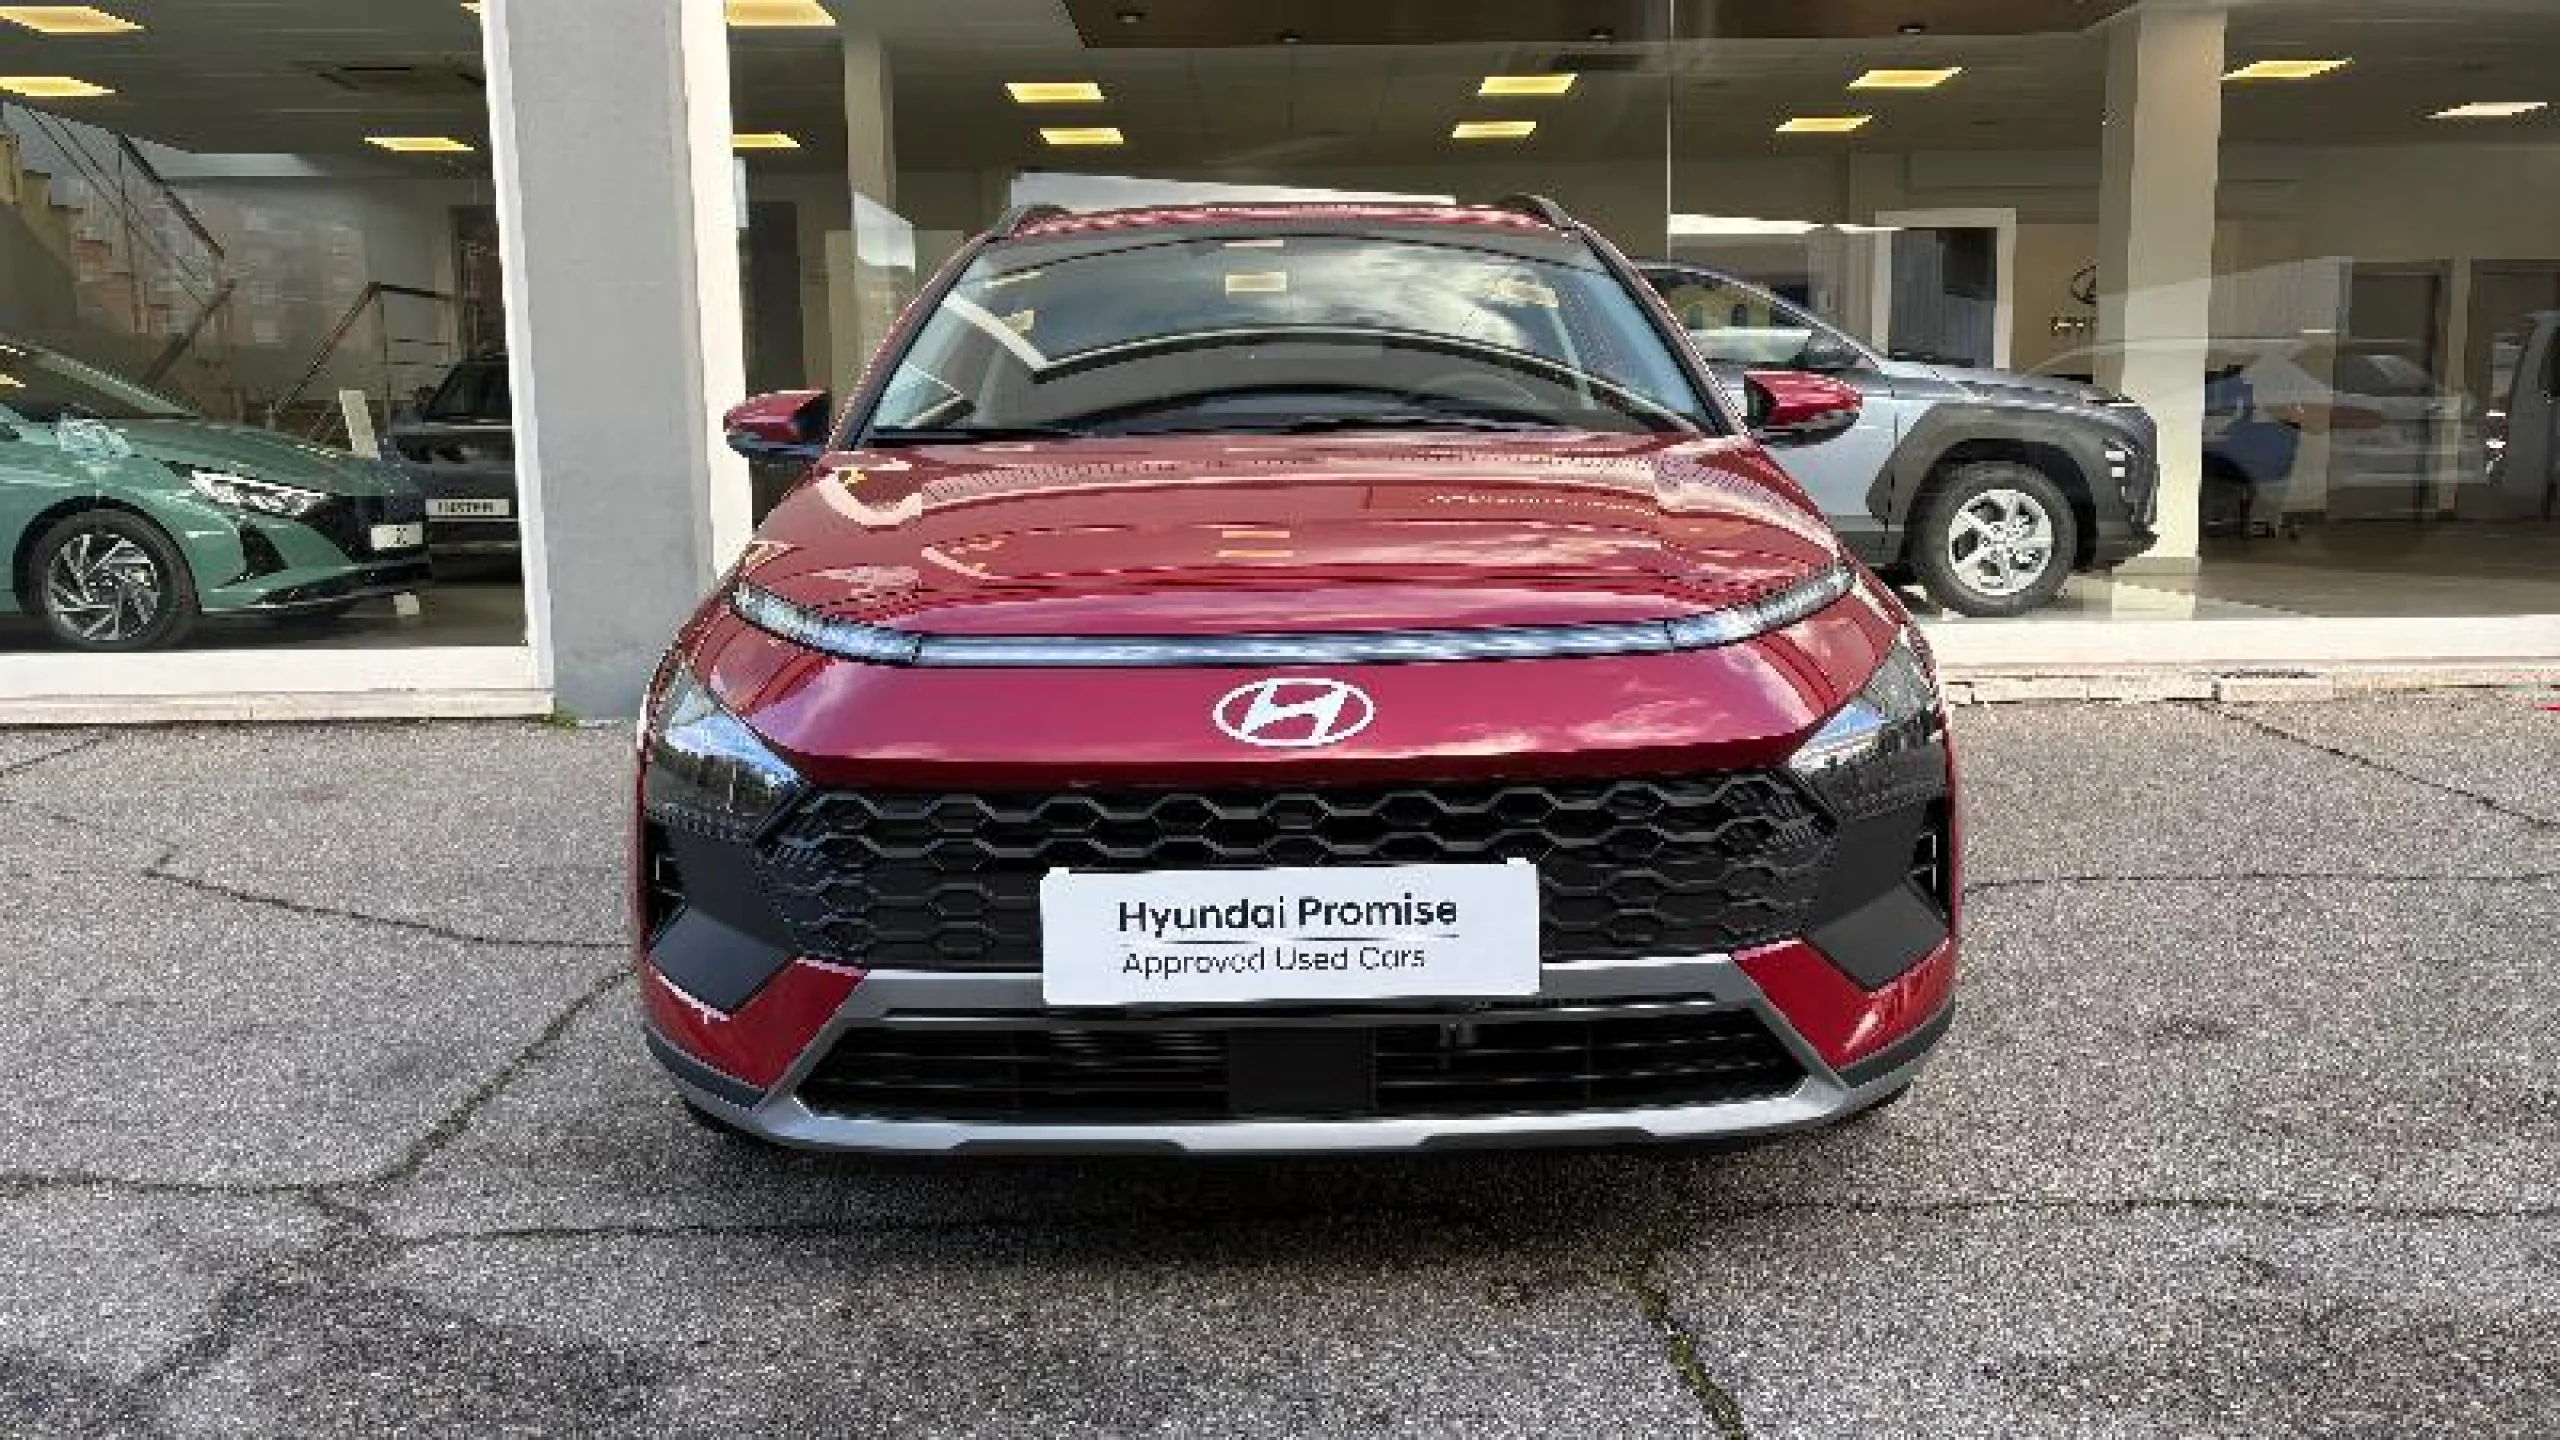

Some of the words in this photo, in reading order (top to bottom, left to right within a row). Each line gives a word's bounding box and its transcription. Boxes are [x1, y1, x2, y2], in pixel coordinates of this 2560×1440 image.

[1119, 895, 1287, 938] Hyundai
[1298, 892, 1457, 926] Promise
[1122, 946, 1264, 979] Approved
[1276, 946, 1347, 970] Used
[1359, 946, 1425, 970] Cars
